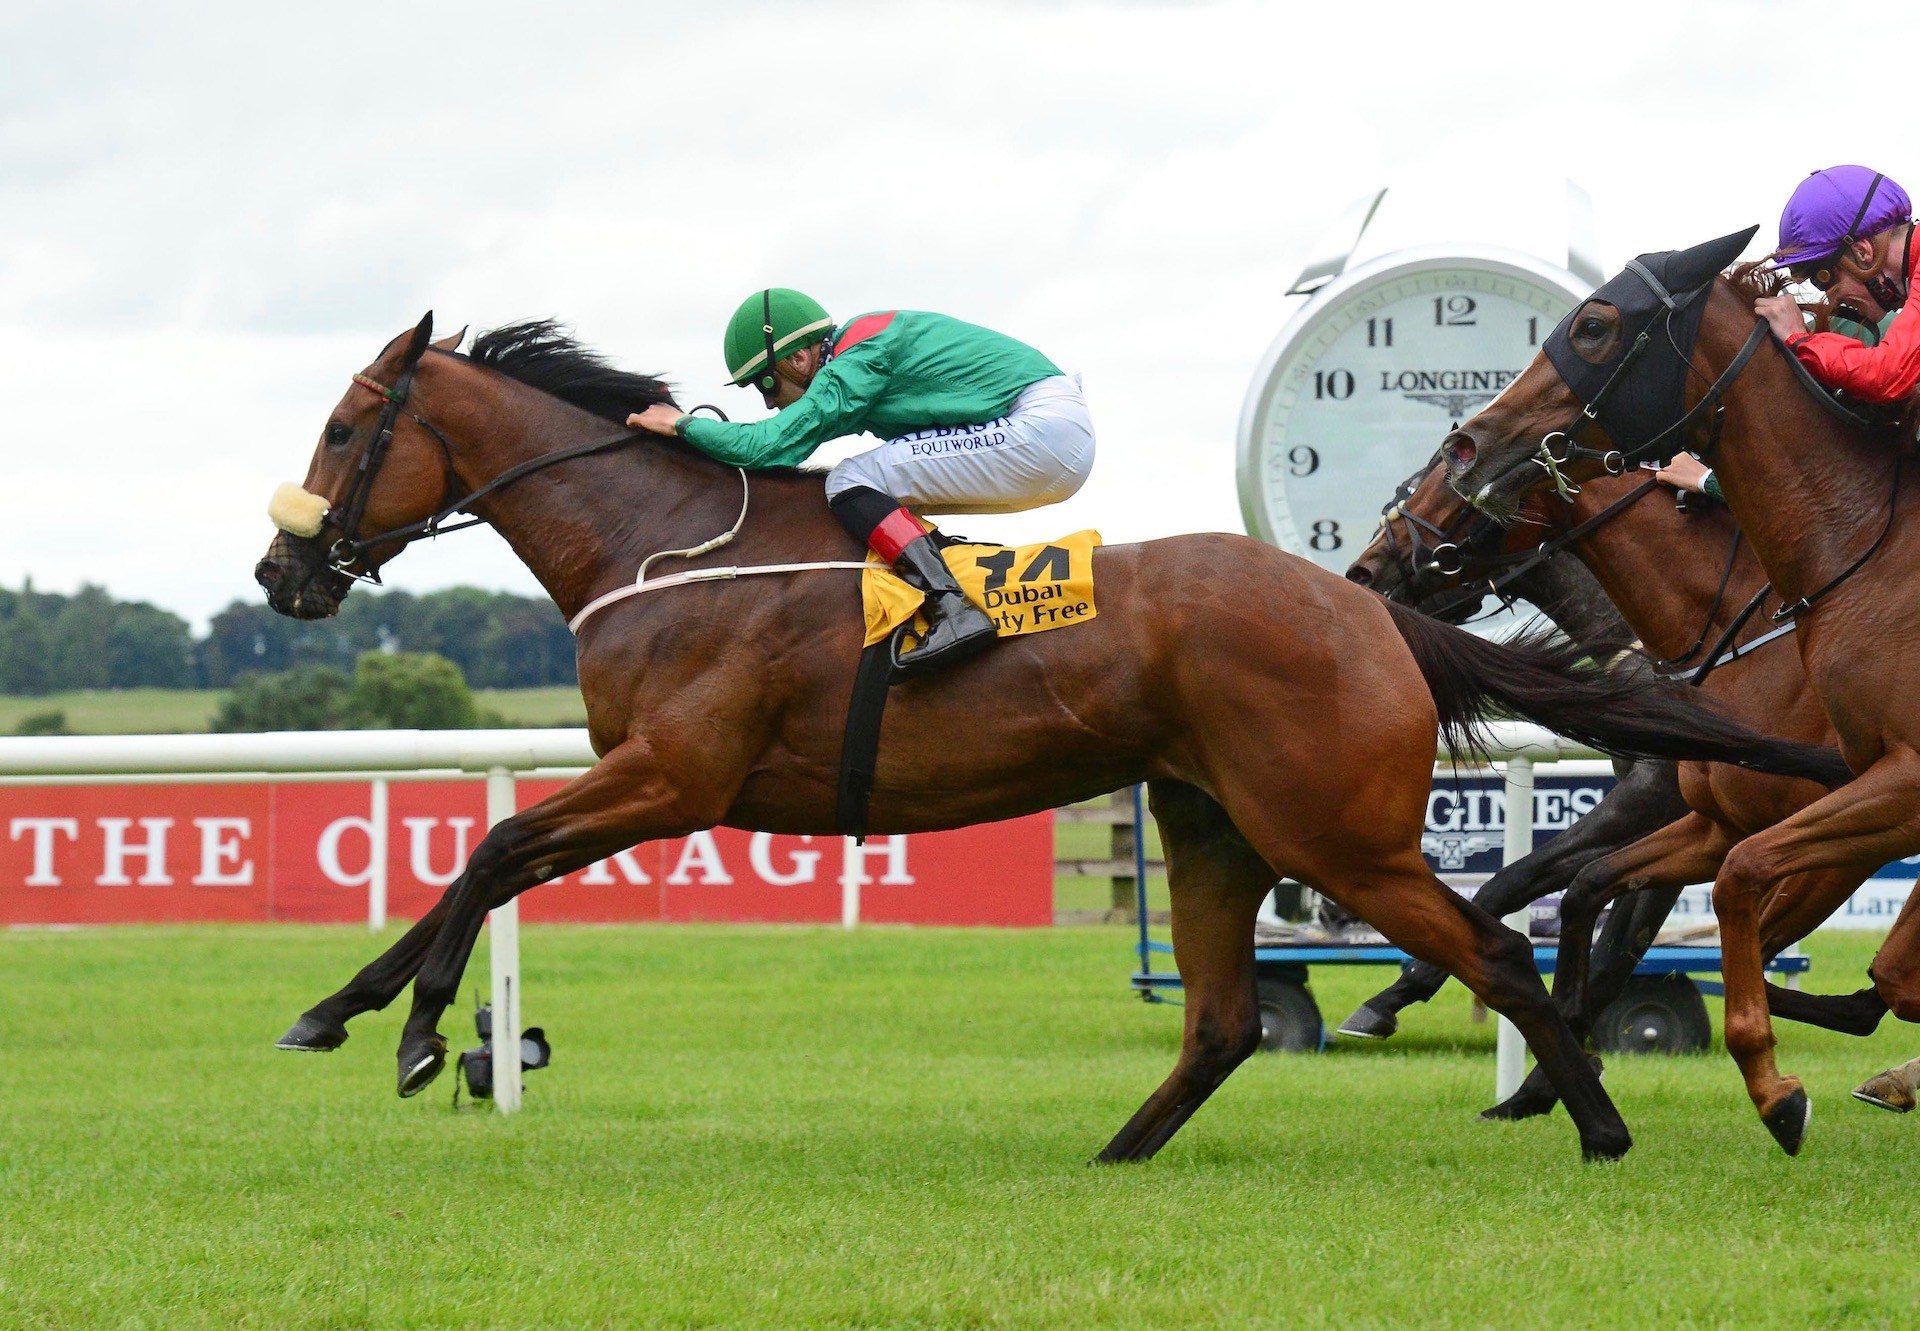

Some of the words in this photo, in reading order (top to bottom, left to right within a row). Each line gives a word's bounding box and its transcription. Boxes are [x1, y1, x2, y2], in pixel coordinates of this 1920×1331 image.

[1432, 294, 1477, 326] 12
[1367, 317, 1393, 347] 11
[1528, 316, 1537, 345] 1
[1314, 368, 1355, 401] 10
[1380, 370, 1521, 392] LONGINE
[911, 432, 1005, 456] EQUIWORLD
[1288, 445, 1319, 477] 9
[1309, 519, 1343, 551] 8
[976, 545, 1070, 591] 14
[983, 584, 1062, 609] Dubai
[1033, 601, 1088, 625] Free
[9, 817, 254, 886] THE
[316, 815, 915, 887] CUAGH
[1846, 895, 1904, 915] Lar
